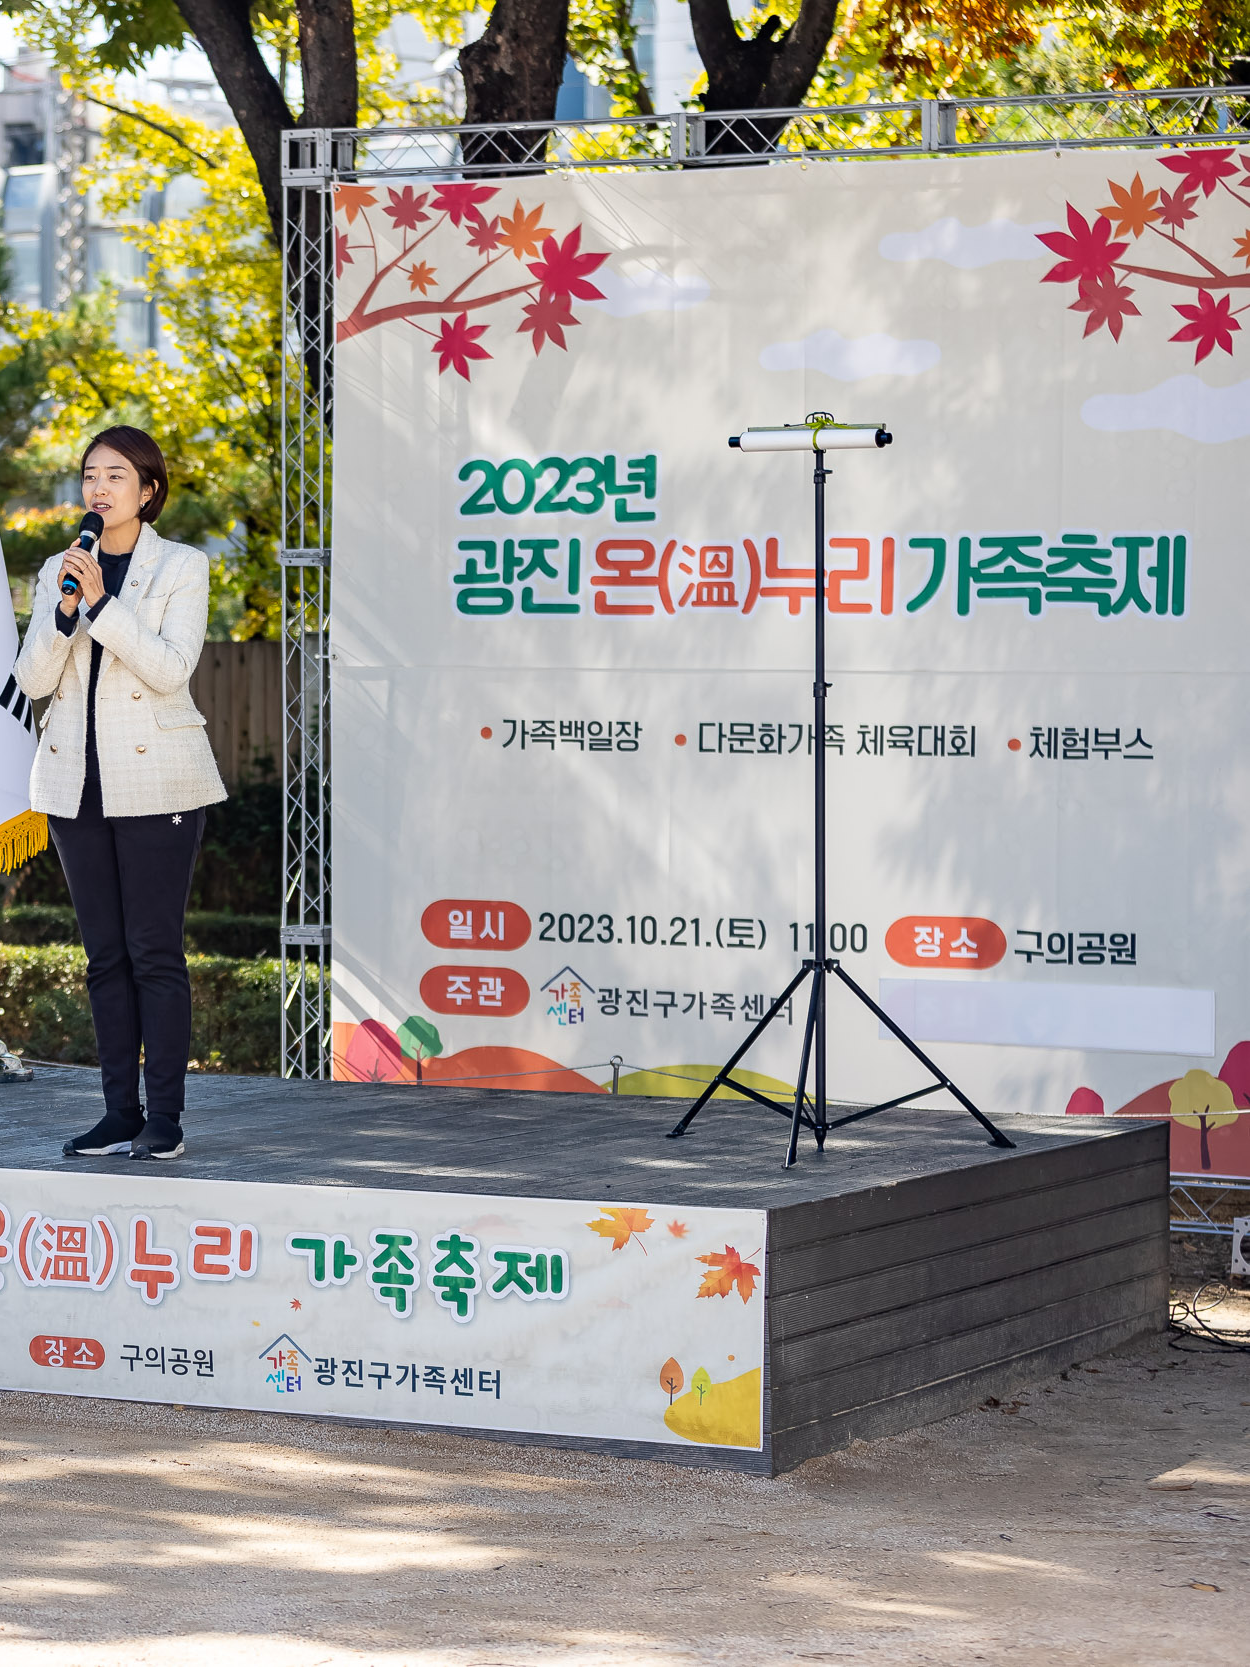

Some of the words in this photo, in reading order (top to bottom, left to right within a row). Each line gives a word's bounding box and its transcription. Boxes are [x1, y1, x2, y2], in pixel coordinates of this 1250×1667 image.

[457, 454, 658, 523] 2023년
[453, 538, 581, 616] 광진
[590, 536, 896, 617] 온(溫)누리
[905, 534, 1187, 618] 가족축제
[501, 719, 644, 752] 가족백일장
[698, 722, 846, 756] 다문화가족
[855, 724, 976, 758] 체육대회
[1028, 726, 1155, 760] 체험부스
[448, 910, 505, 942] 일시
[538, 912, 767, 951] 2023.10.21.(토)
[789, 922, 868, 954] 1100
[913, 926, 979, 960] 장소
[1014, 929, 1138, 967] 구의공원
[446, 976, 506, 1007] 주관
[548, 982, 582, 1009] 가족
[596, 987, 794, 1026] 광진구가족센터
[547, 1002, 585, 1026] 센터
[290, 1233, 564, 1318] 가족축제
[44, 1338, 97, 1368] 장소
[119, 1343, 215, 1378] 구의공원
[266, 1349, 300, 1377] 가족
[265, 1369, 302, 1394] 센터
[313, 1356, 502, 1400] 광진구가족센터
